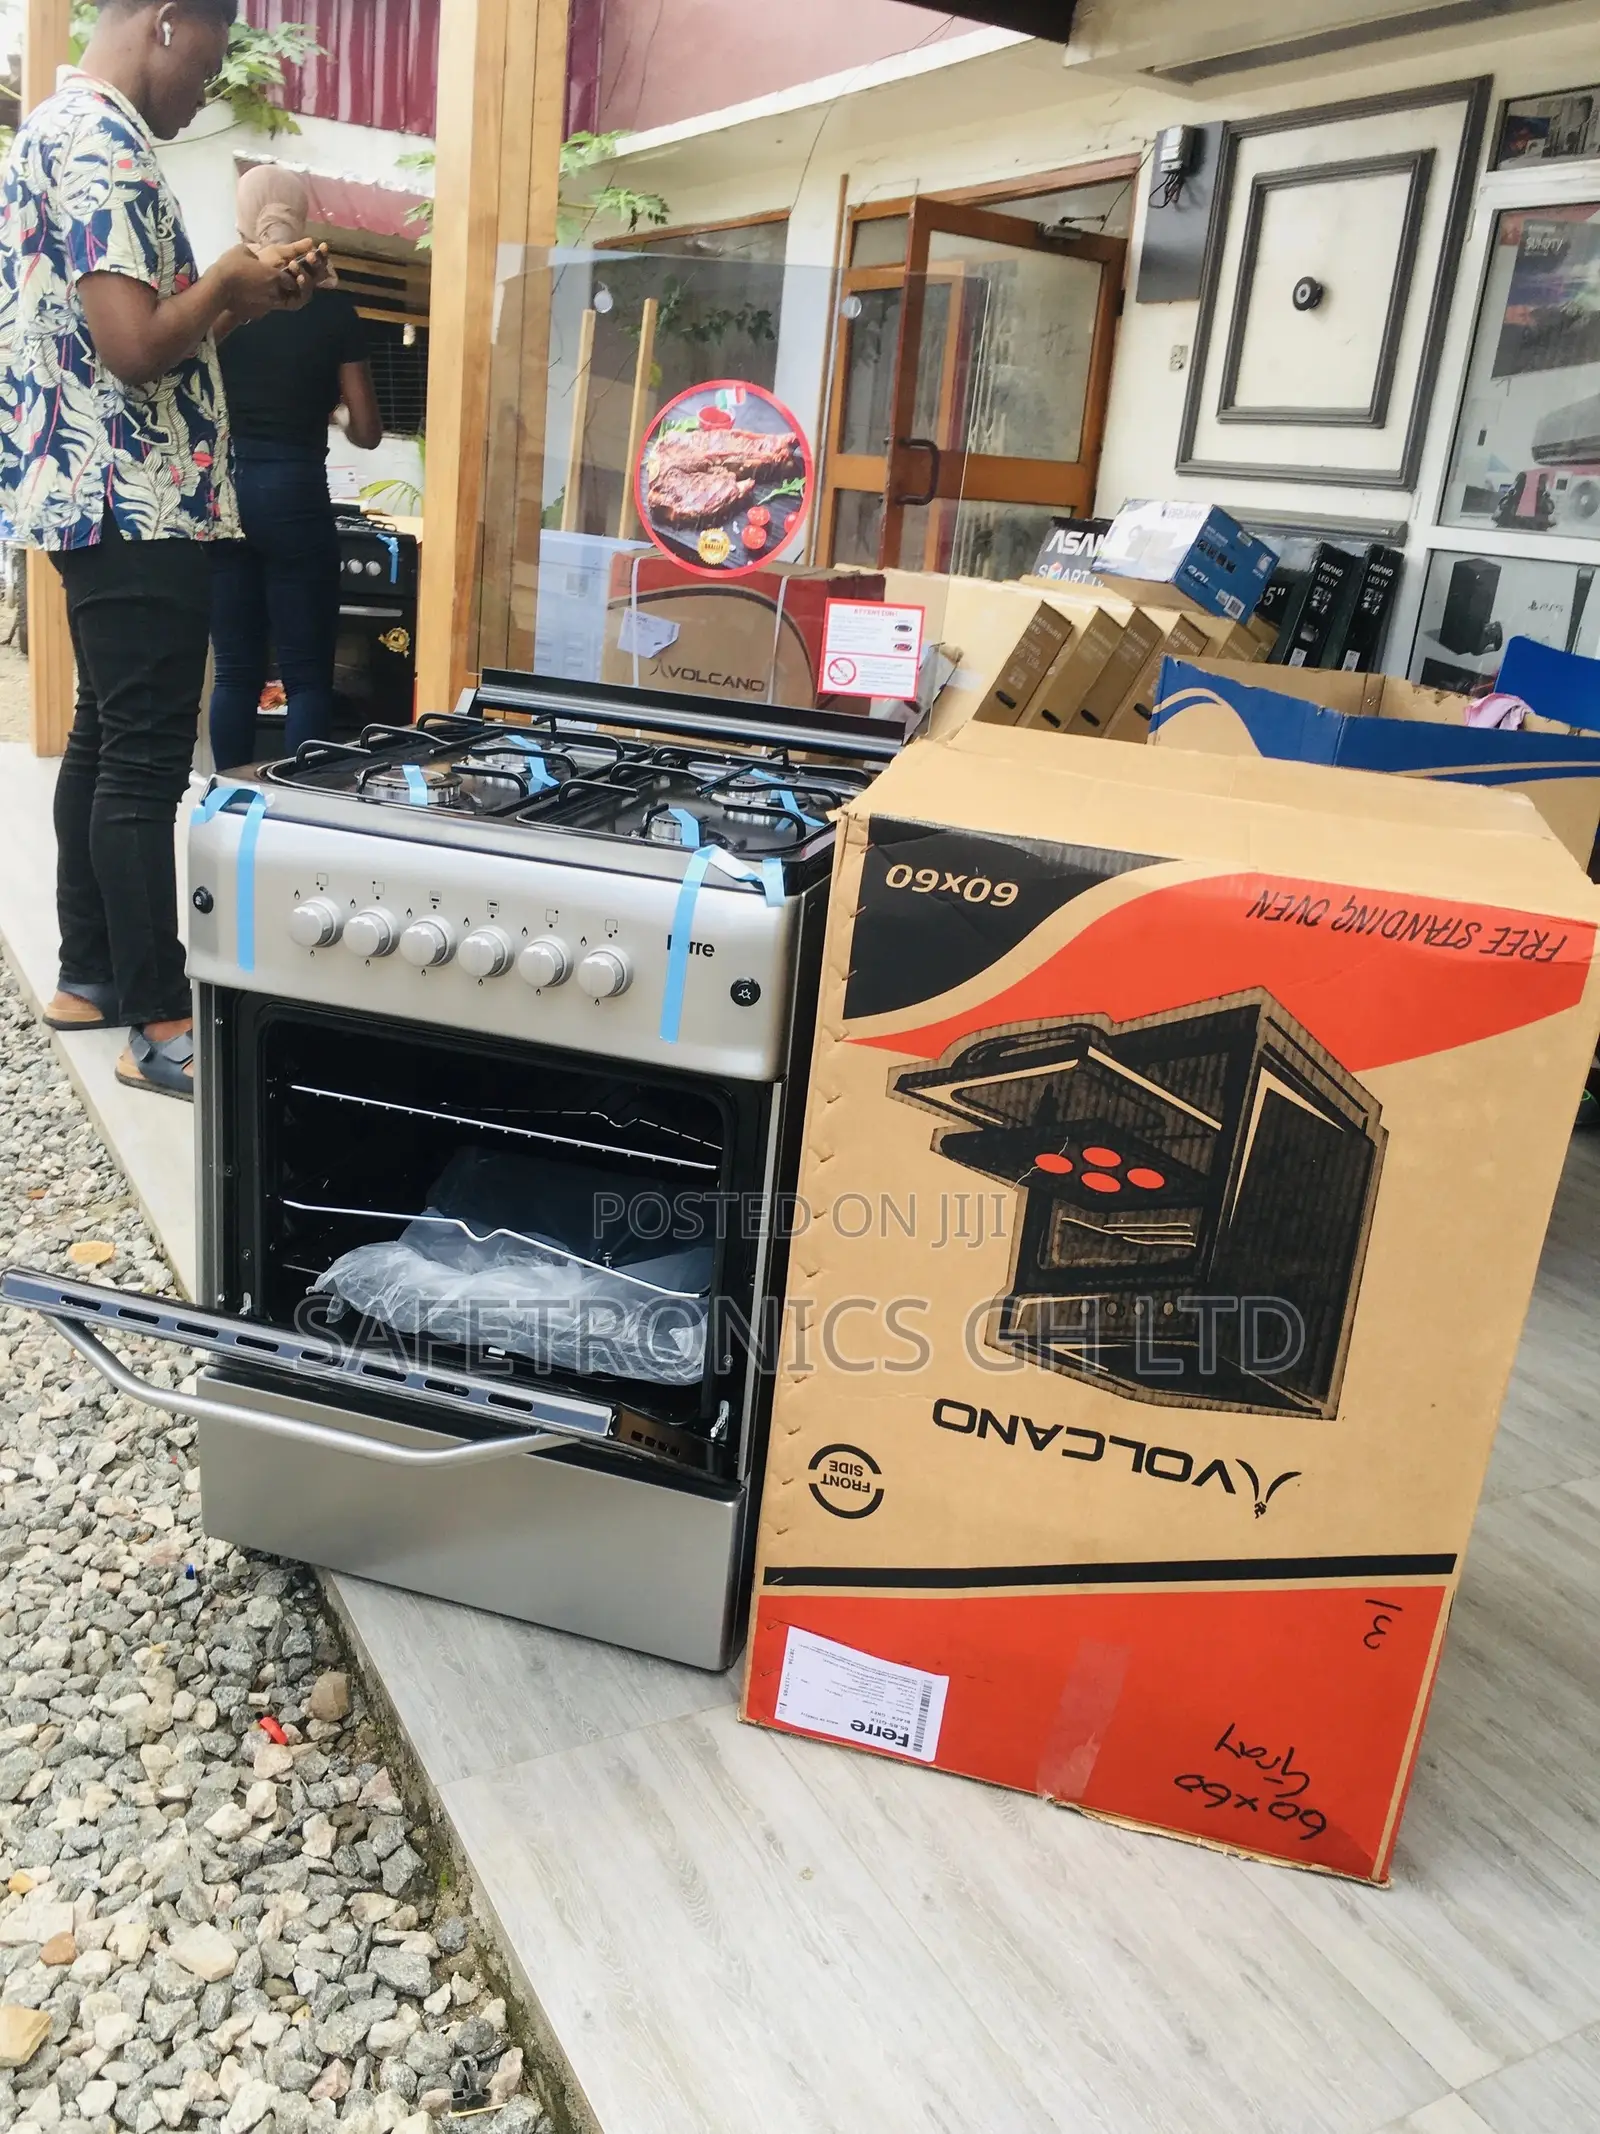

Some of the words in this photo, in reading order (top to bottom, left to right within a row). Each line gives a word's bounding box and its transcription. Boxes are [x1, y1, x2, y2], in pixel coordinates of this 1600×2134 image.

[1317, 573, 1330, 584] LED
[1329, 579, 1339, 588] TV
[1319, 561, 1344, 577] ASANO
[1367, 574, 1380, 585] LED
[1380, 580, 1389, 588] TV
[1369, 563, 1394, 577] ASANO
[668, 665, 765, 693] VOLCANO
[1246, 889, 1330, 927] OVEN
[1331, 895, 1482, 950] STANDING
[1478, 926, 1567, 962] FREE
[932, 1398, 1236, 1495] VOLCANO
[829, 1460, 864, 1477] SIDE
[820, 1473, 871, 1494] FRONT
[850, 1718, 911, 1749] Ferre
[1213, 1722, 1311, 1799] Gray
